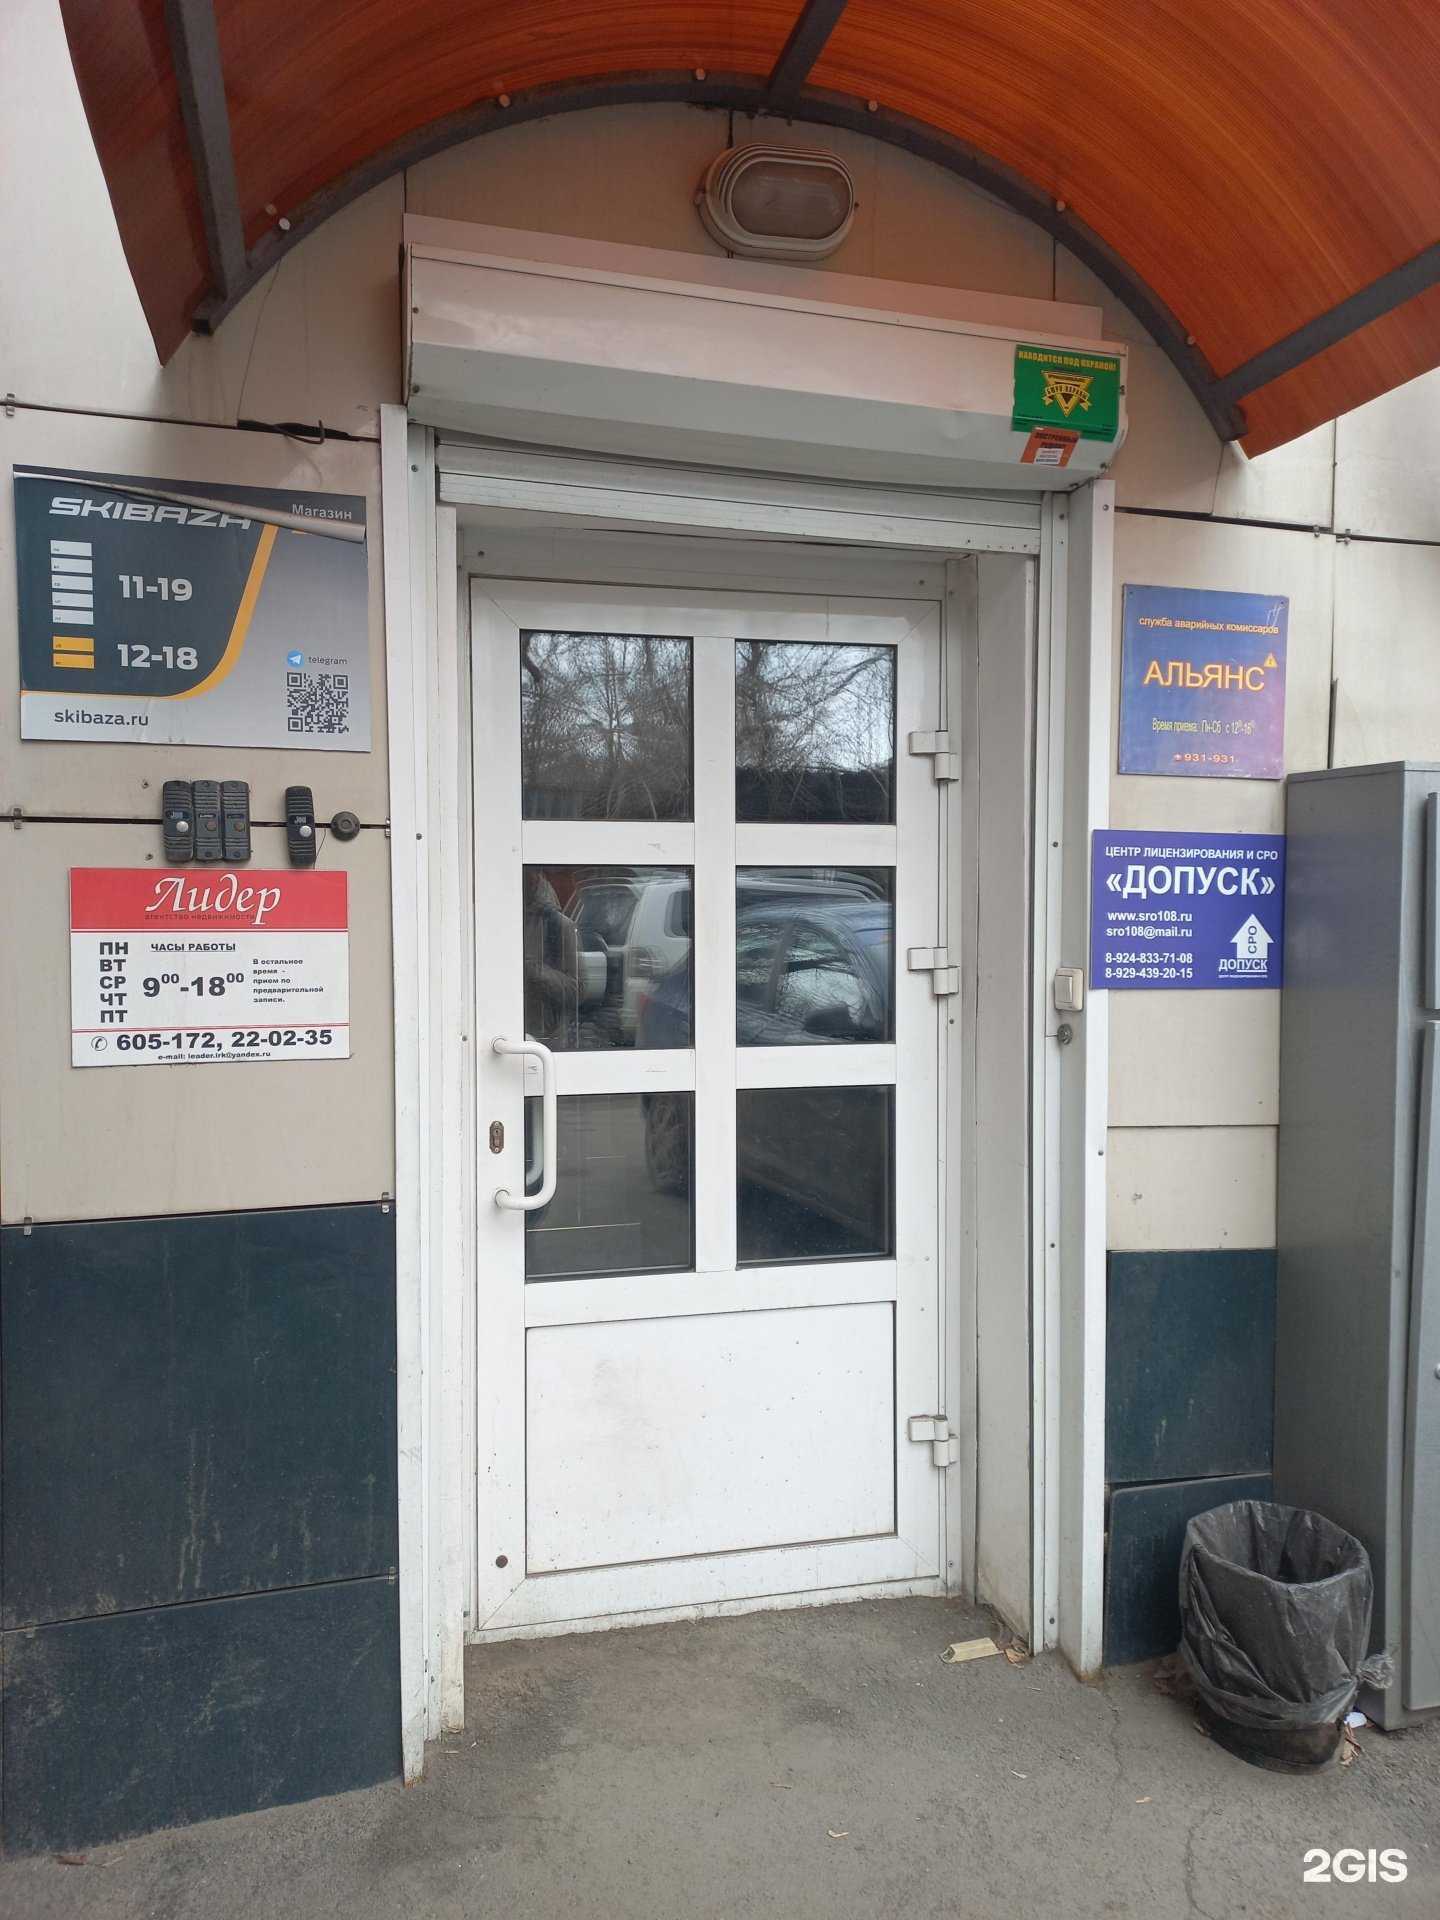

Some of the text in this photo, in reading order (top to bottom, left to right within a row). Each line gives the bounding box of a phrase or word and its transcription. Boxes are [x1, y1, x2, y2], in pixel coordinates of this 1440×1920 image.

[292, 503, 352, 520] Магазин
[119, 575, 193, 601] 11-19
[1140, 617, 1279, 635] служба аварийных комиссаров
[117, 643, 199, 670] 12-18
[308, 655, 348, 666] telegram
[1143, 660, 1265, 691] АЛЬЯНС
[54, 709, 149, 726] skibaza.ru
[1105, 847, 1278, 860] ЦЕНТР ЛИЦЕНЗИРОВАНИЯ И СРО
[1106, 864, 1276, 899] «ДОПУСК»
[145, 873, 281, 926] Лидер
[1107, 911, 1193, 922] www.sro108.ru
[1106, 926, 1193, 939] sro108@mail.ru
[1248, 926, 1257, 954] СРО
[99, 942, 129, 955] ПН
[151, 943, 236, 951] ЧАСЫ РАБОТЫ
[1105, 953, 1193, 964] 8-924-833-71-08
[100, 959, 126, 972] ВТ
[1218, 959, 1268, 972] ДОПУСК
[1105, 968, 1193, 979] 8-929-439-20-15
[100, 976, 127, 989] СР
[253, 986, 324, 994] предварительной
[100, 992, 127, 1006] ЧТ
[100, 1009, 128, 1023] ПТ
[117, 1029, 333, 1051] 605-172, 22-02-35
[158, 1050, 271, 1061] e-mail: leader.irk@yandex.ru
